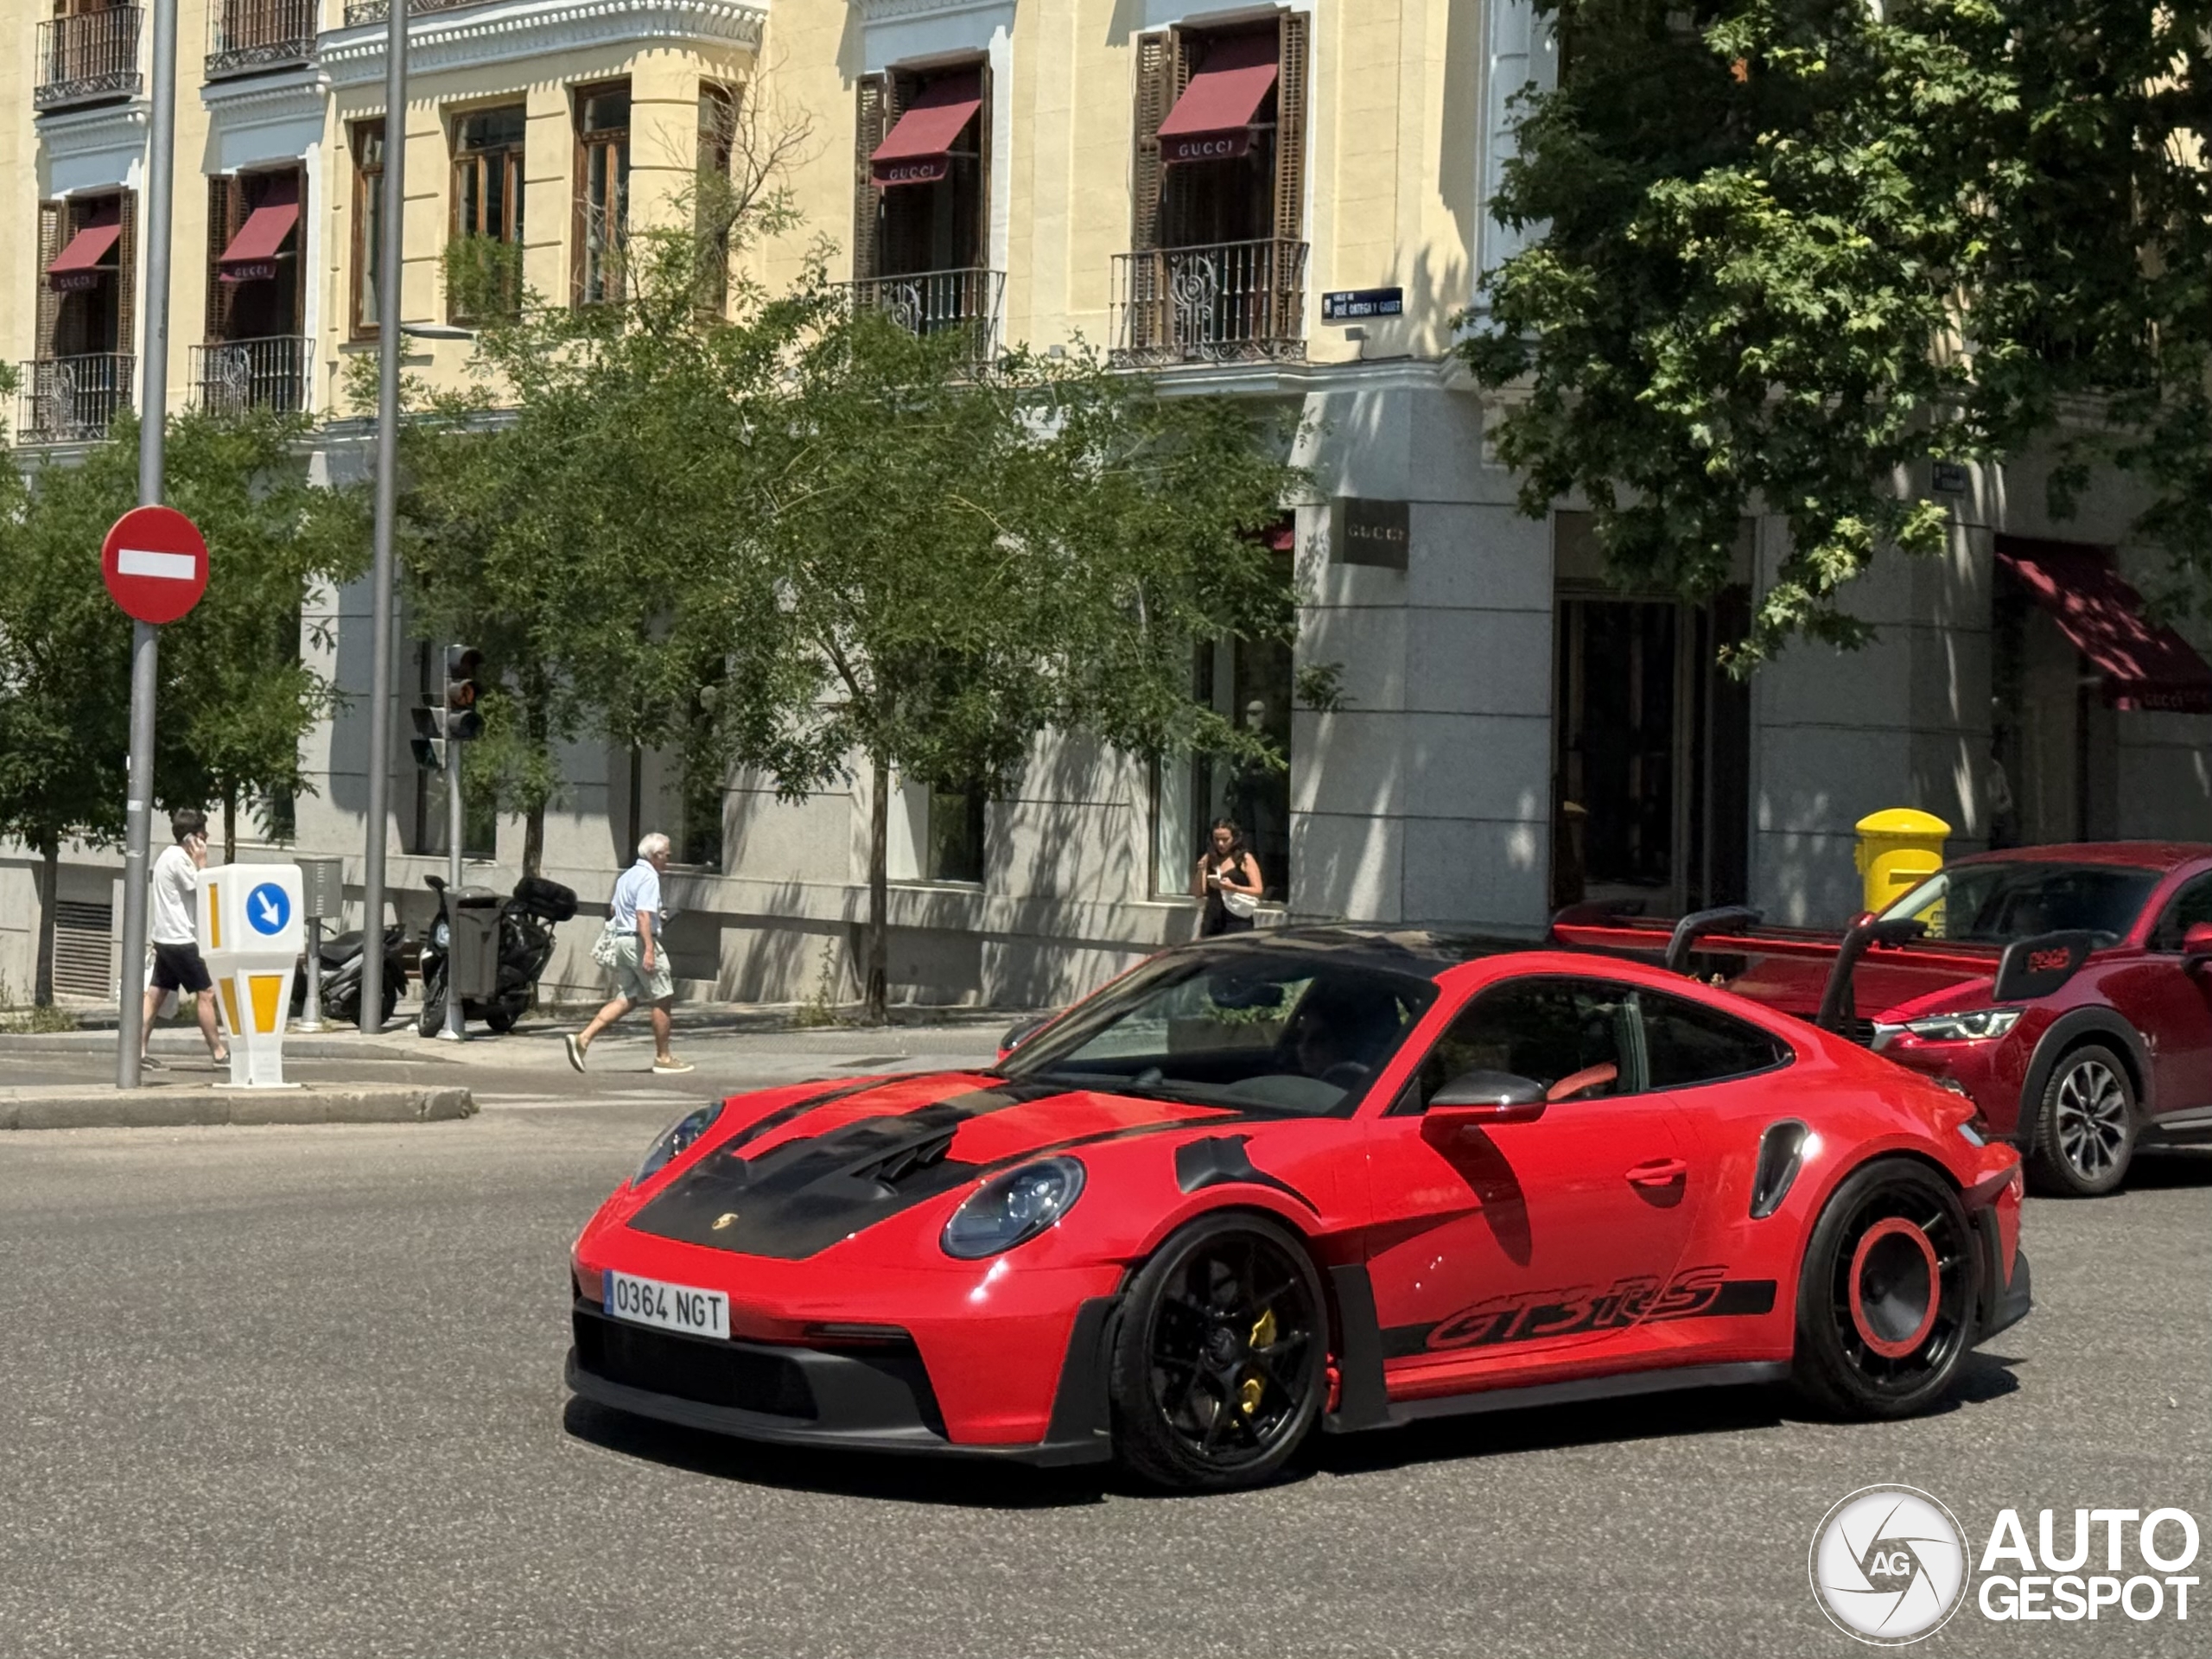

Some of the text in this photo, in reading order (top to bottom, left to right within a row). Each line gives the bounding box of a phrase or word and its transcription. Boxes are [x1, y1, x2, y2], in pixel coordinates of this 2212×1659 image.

[1179, 140, 1233, 156] GUCCI
[889, 164, 934, 180] GUCCI
[234, 264, 268, 276] GUCCI
[1348, 524, 1405, 541] GUCCI
[617, 1279, 721, 1331] 0364 NGT
